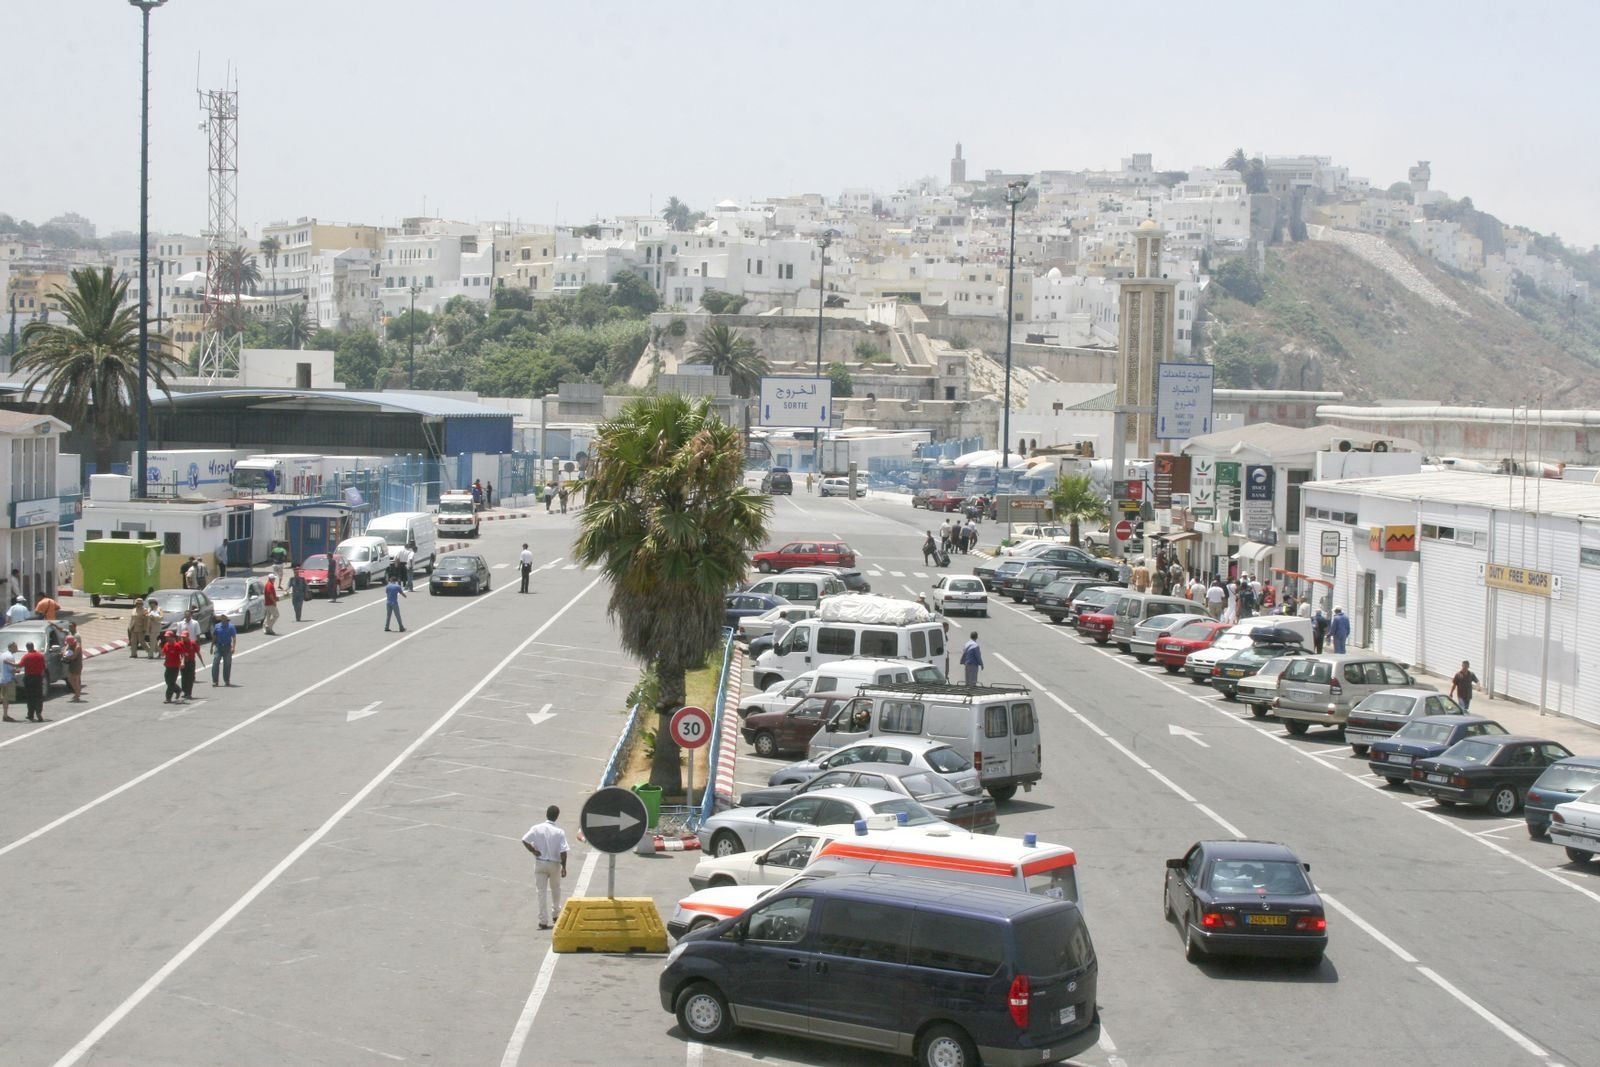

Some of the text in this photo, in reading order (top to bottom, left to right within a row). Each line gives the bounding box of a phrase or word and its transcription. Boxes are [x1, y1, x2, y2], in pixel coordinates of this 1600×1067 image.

[776, 384, 816, 399] الخروج
[1489, 566, 1548, 588] DUTY FREE SHOPS
[683, 722, 700, 736] 30
